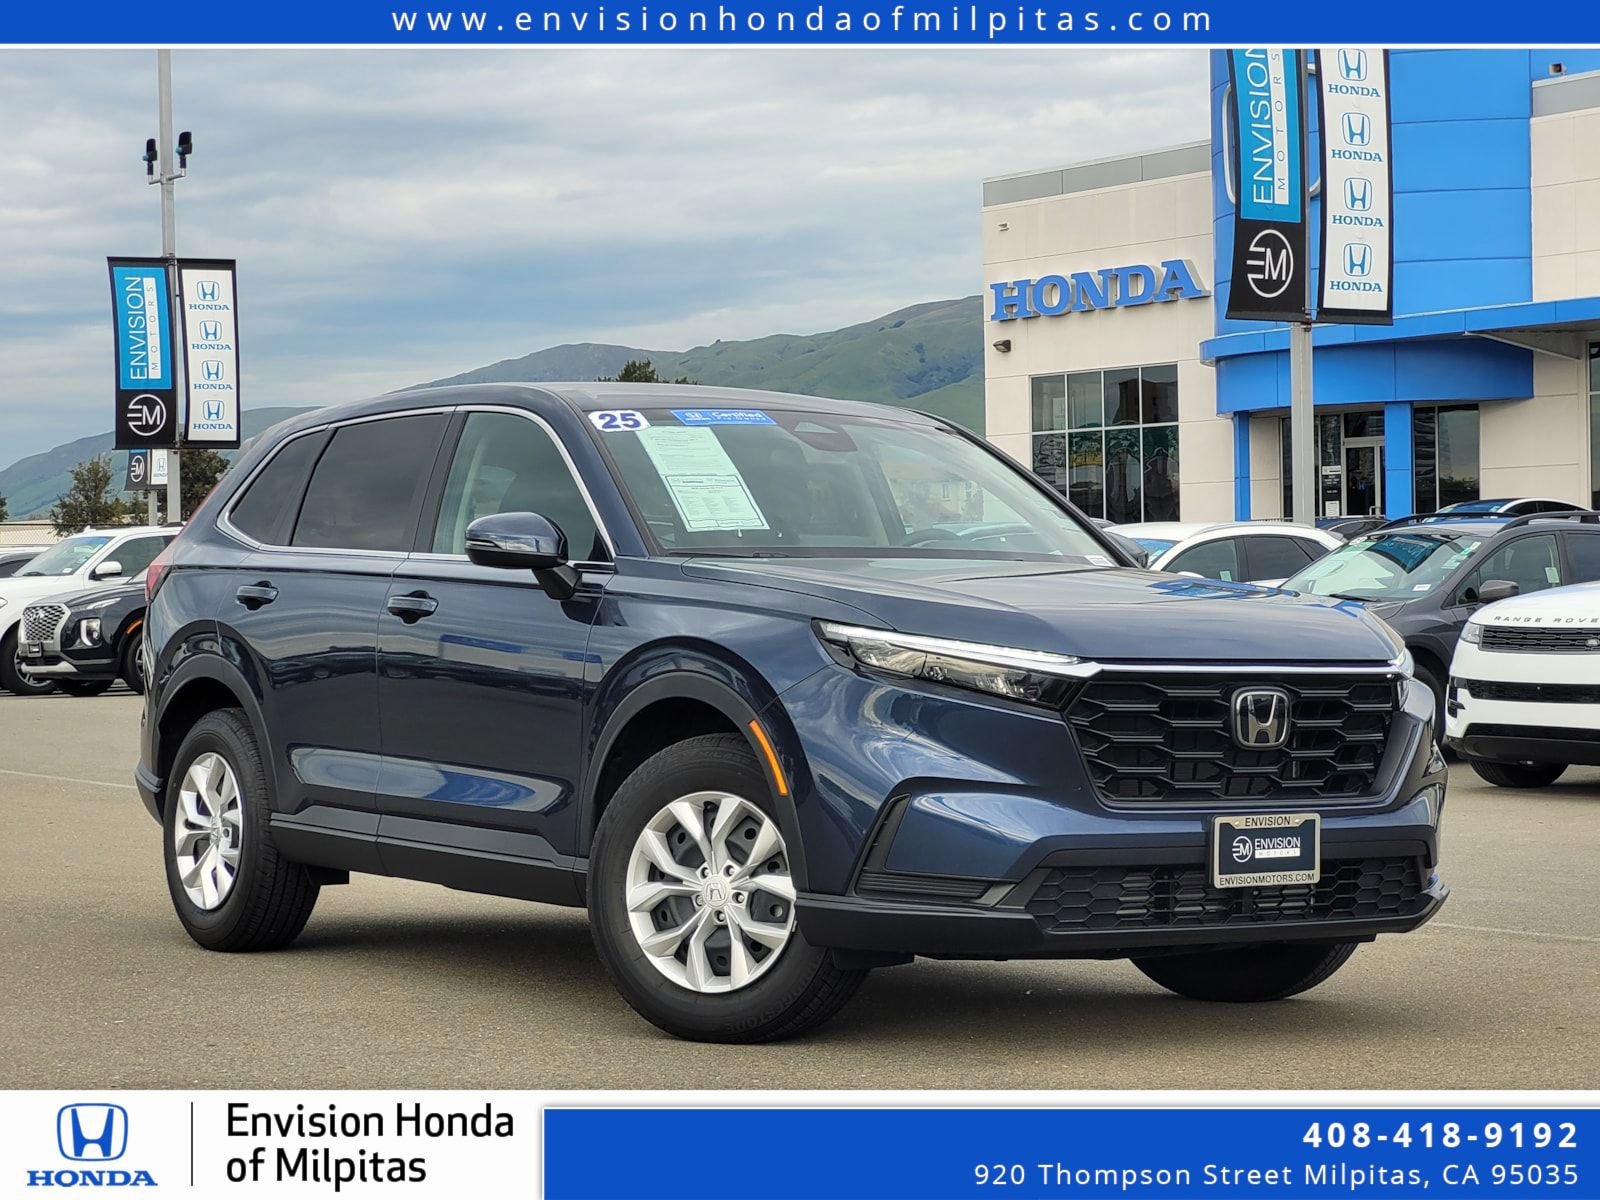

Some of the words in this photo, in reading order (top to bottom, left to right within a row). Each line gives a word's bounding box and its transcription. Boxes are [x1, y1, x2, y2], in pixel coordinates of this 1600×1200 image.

[1328, 83, 1381, 98] HONDA
[1271, 53, 1286, 190] MOTORS
[1331, 149, 1383, 162] HONDA
[1331, 214, 1384, 228] HONDA
[990, 258, 1208, 321] HONDA
[1329, 280, 1383, 292] HONDA
[188, 303, 230, 311] HONDA
[124, 276, 148, 380] ENVISION
[146, 286, 159, 371] MOTORS
[191, 343, 232, 351] HONDA
[598, 413, 641, 429] 25
[1245, 816, 1291, 827] ENVISION
[1254, 837, 1301, 850] ENVISION
[1220, 873, 1315, 886] ENVISIONMOTORS.COM
